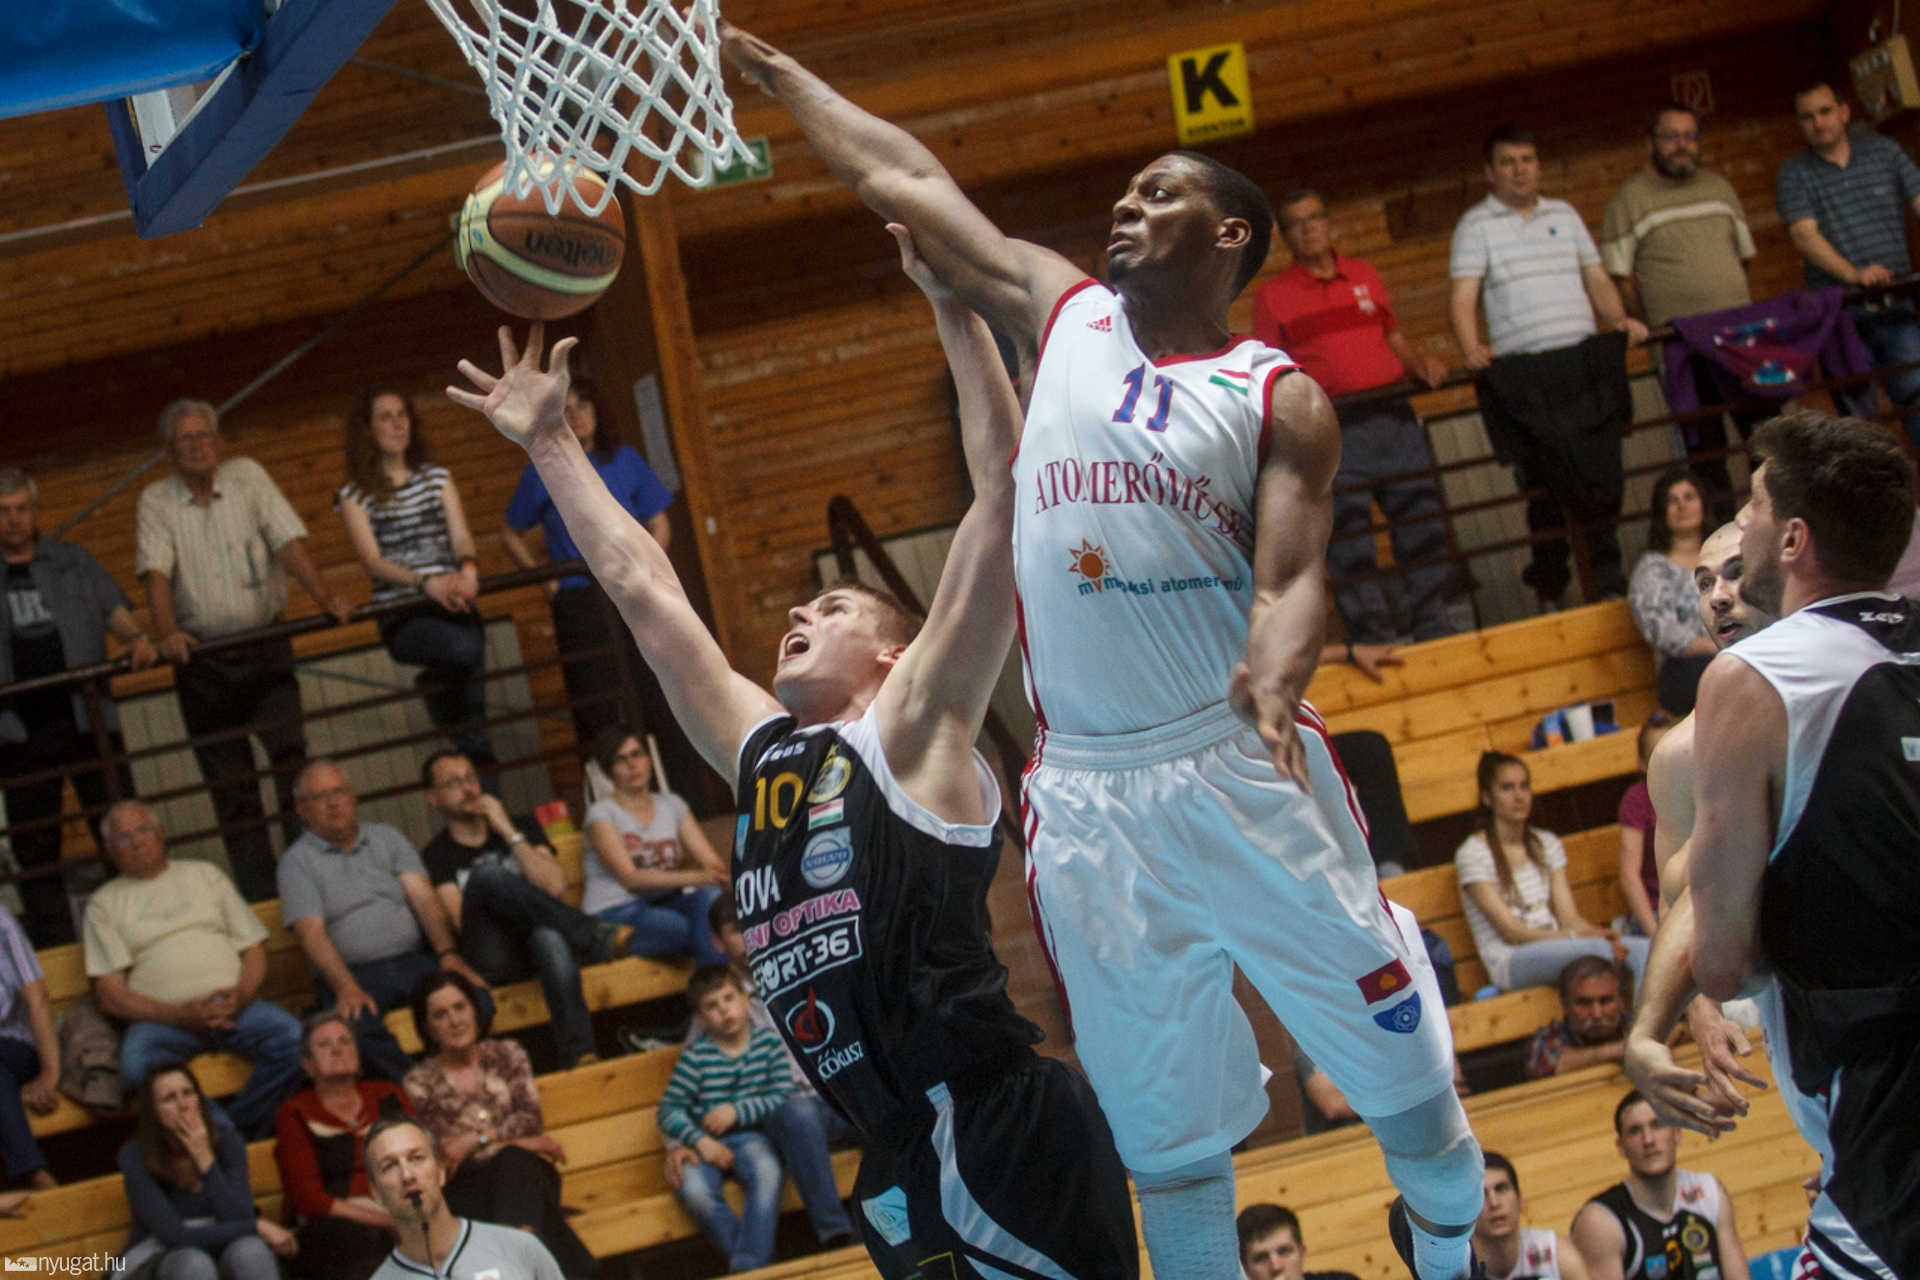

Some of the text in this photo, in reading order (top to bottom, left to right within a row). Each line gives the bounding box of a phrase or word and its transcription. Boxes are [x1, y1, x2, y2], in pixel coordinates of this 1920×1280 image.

[1181, 50, 1240, 113] K
[1111, 360, 1174, 432] 11
[754, 772, 803, 830] 10
[773, 888, 861, 937] OPTIKA
